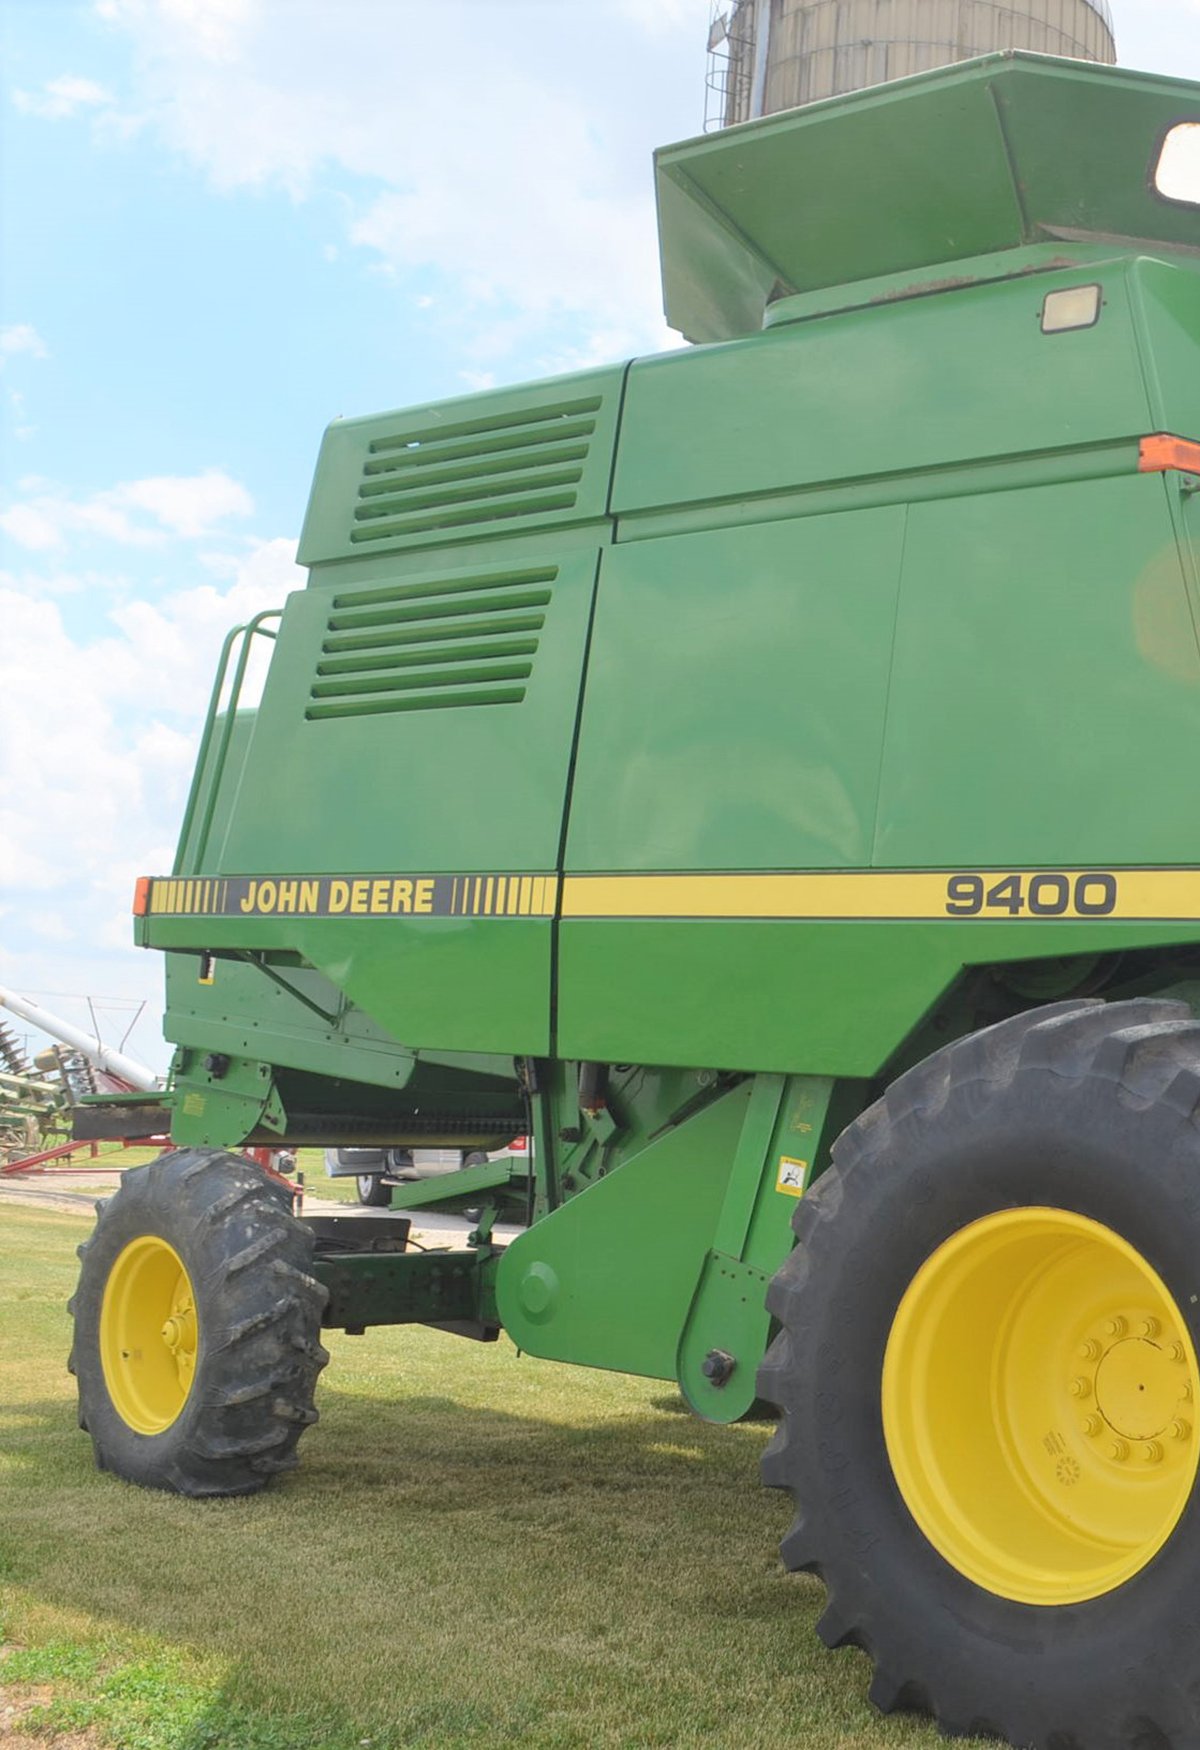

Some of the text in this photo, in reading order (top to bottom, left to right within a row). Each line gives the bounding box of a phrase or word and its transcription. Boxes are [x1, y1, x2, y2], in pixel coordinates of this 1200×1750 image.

[240, 879, 435, 913] JOHN DEERE
[945, 873, 1117, 915] 9400
